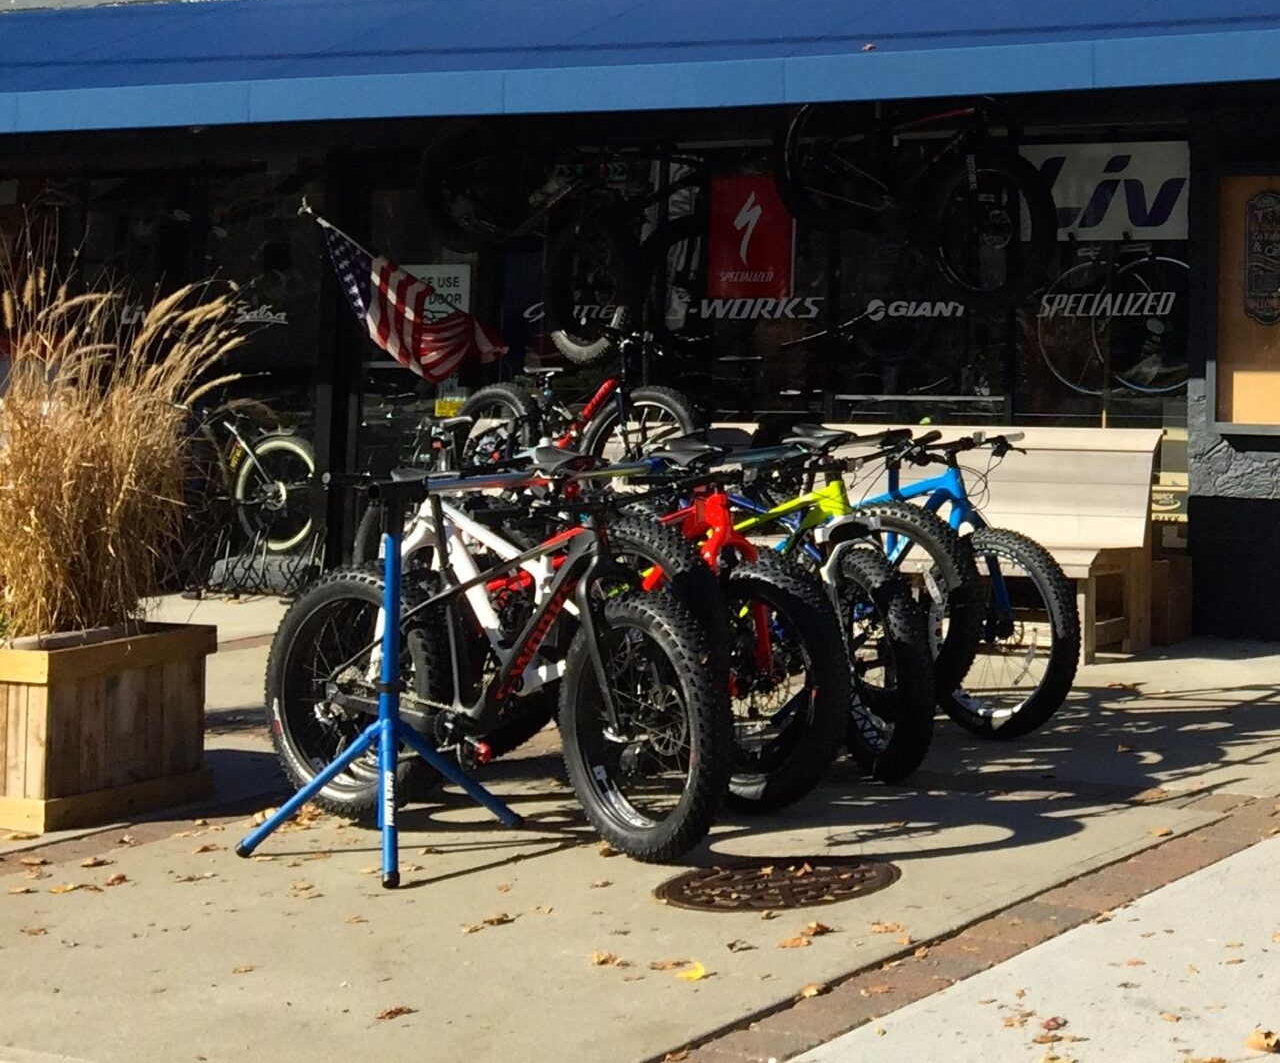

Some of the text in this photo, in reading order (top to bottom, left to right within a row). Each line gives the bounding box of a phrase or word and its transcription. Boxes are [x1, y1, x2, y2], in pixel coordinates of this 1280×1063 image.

[437, 276, 460, 288] USE
[719, 270, 774, 282] SPECIALIZED
[233, 300, 289, 325] Salsa
[1036, 291, 1177, 318] SPECIALIZED
